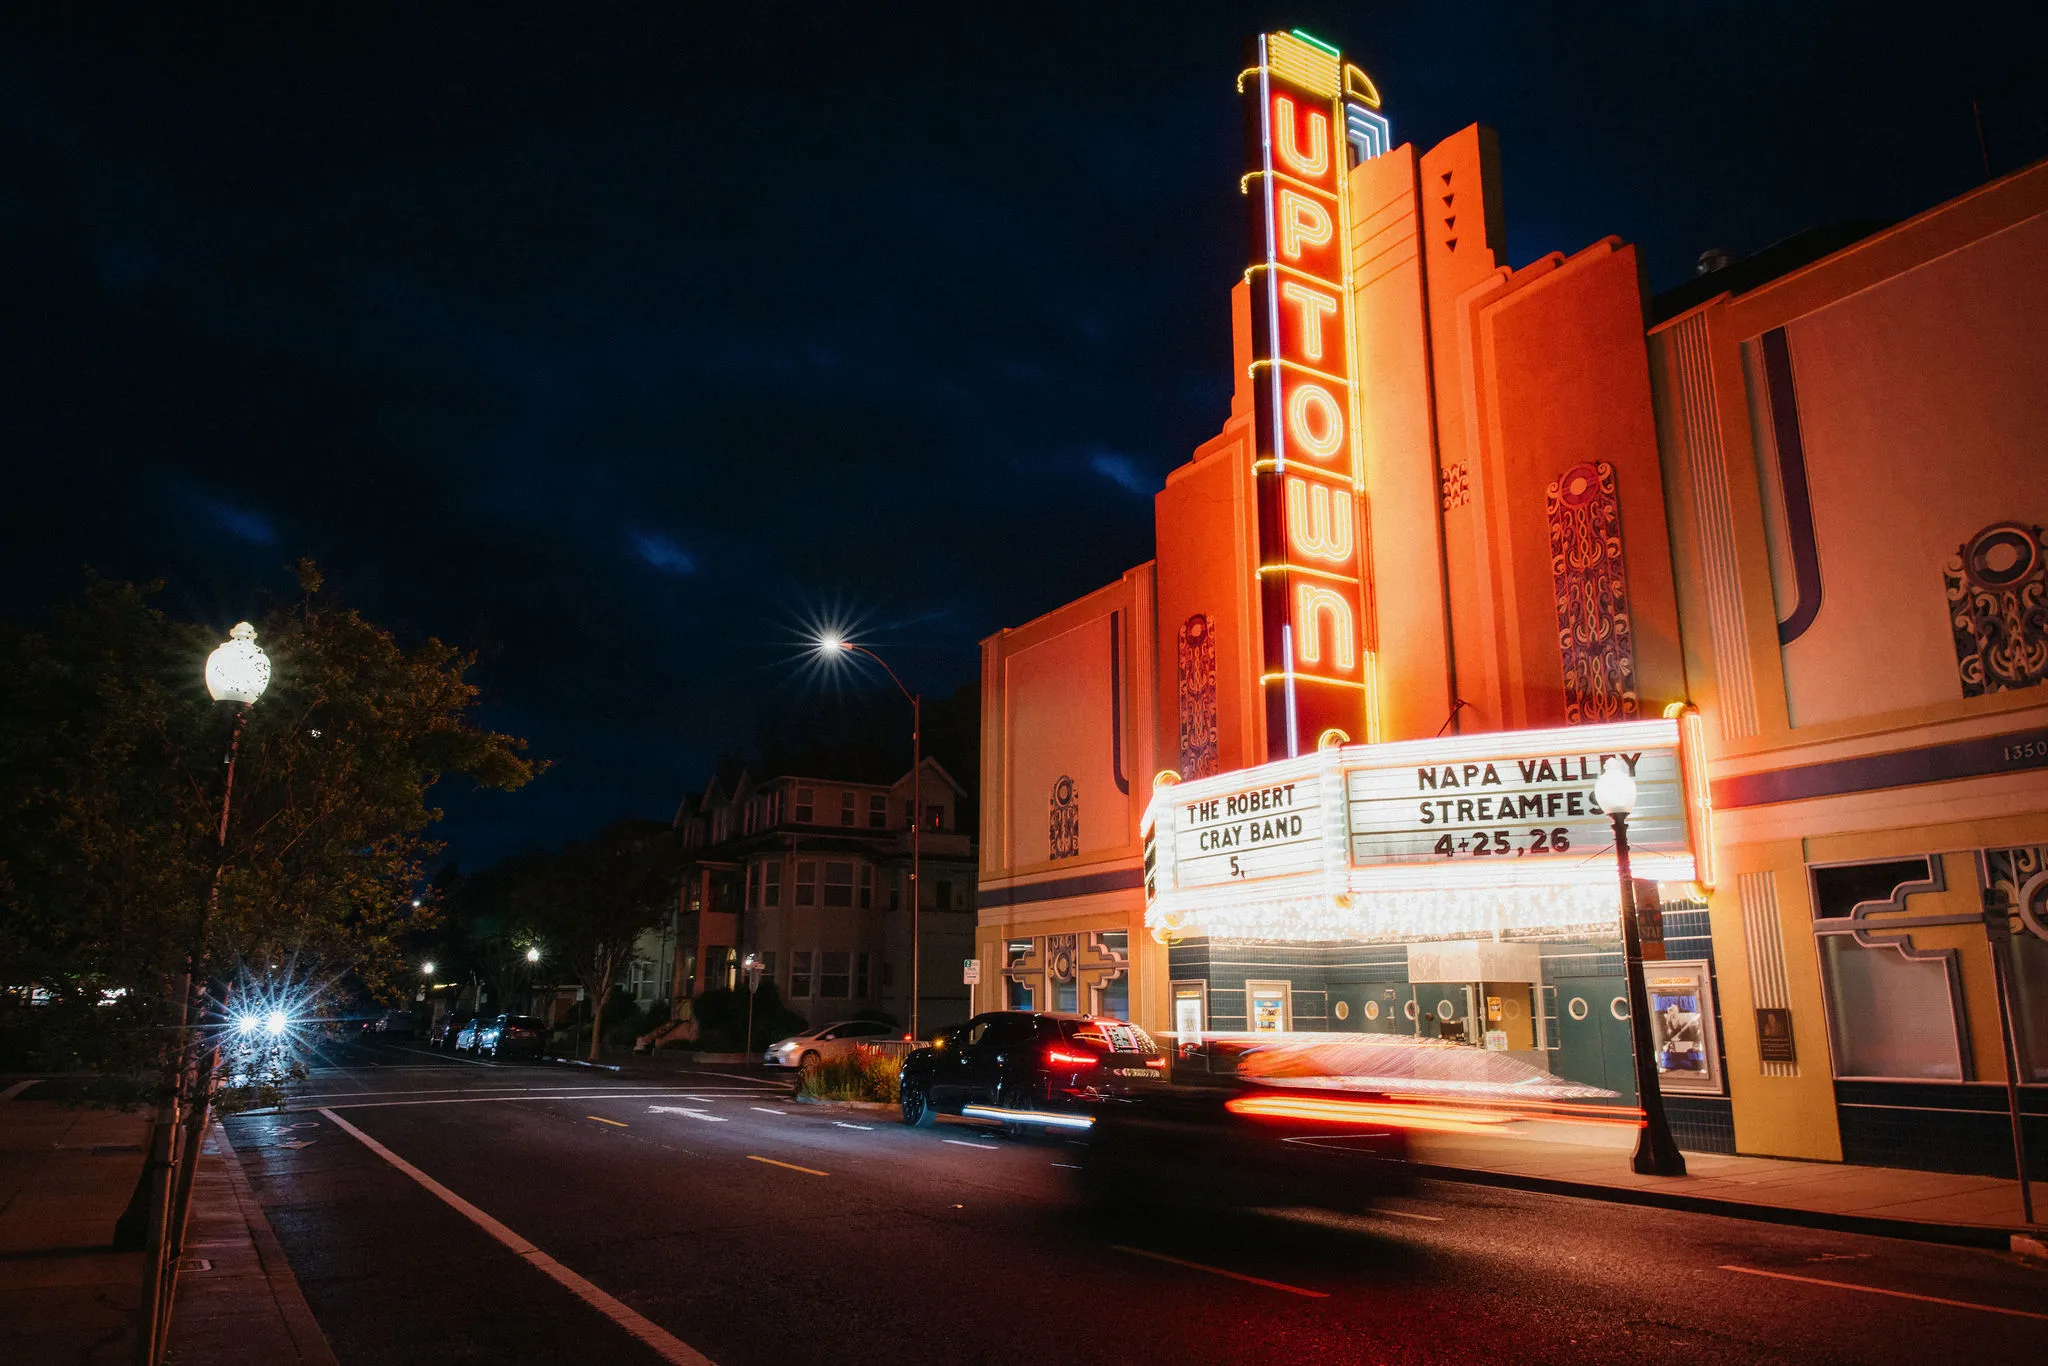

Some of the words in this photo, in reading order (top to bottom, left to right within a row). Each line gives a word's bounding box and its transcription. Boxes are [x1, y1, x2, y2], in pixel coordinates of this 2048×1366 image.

[1278, 96, 1354, 669] UPTOWN
[2004, 741, 2047, 761] 1350
[1417, 763, 1502, 790] NAPA
[1187, 800, 1219, 824] THE
[1227, 784, 1295, 816] ROBERT
[1419, 790, 1605, 824] STREAMFES
[1200, 825, 1243, 851] CRAY
[1250, 815, 1302, 842] BAND
